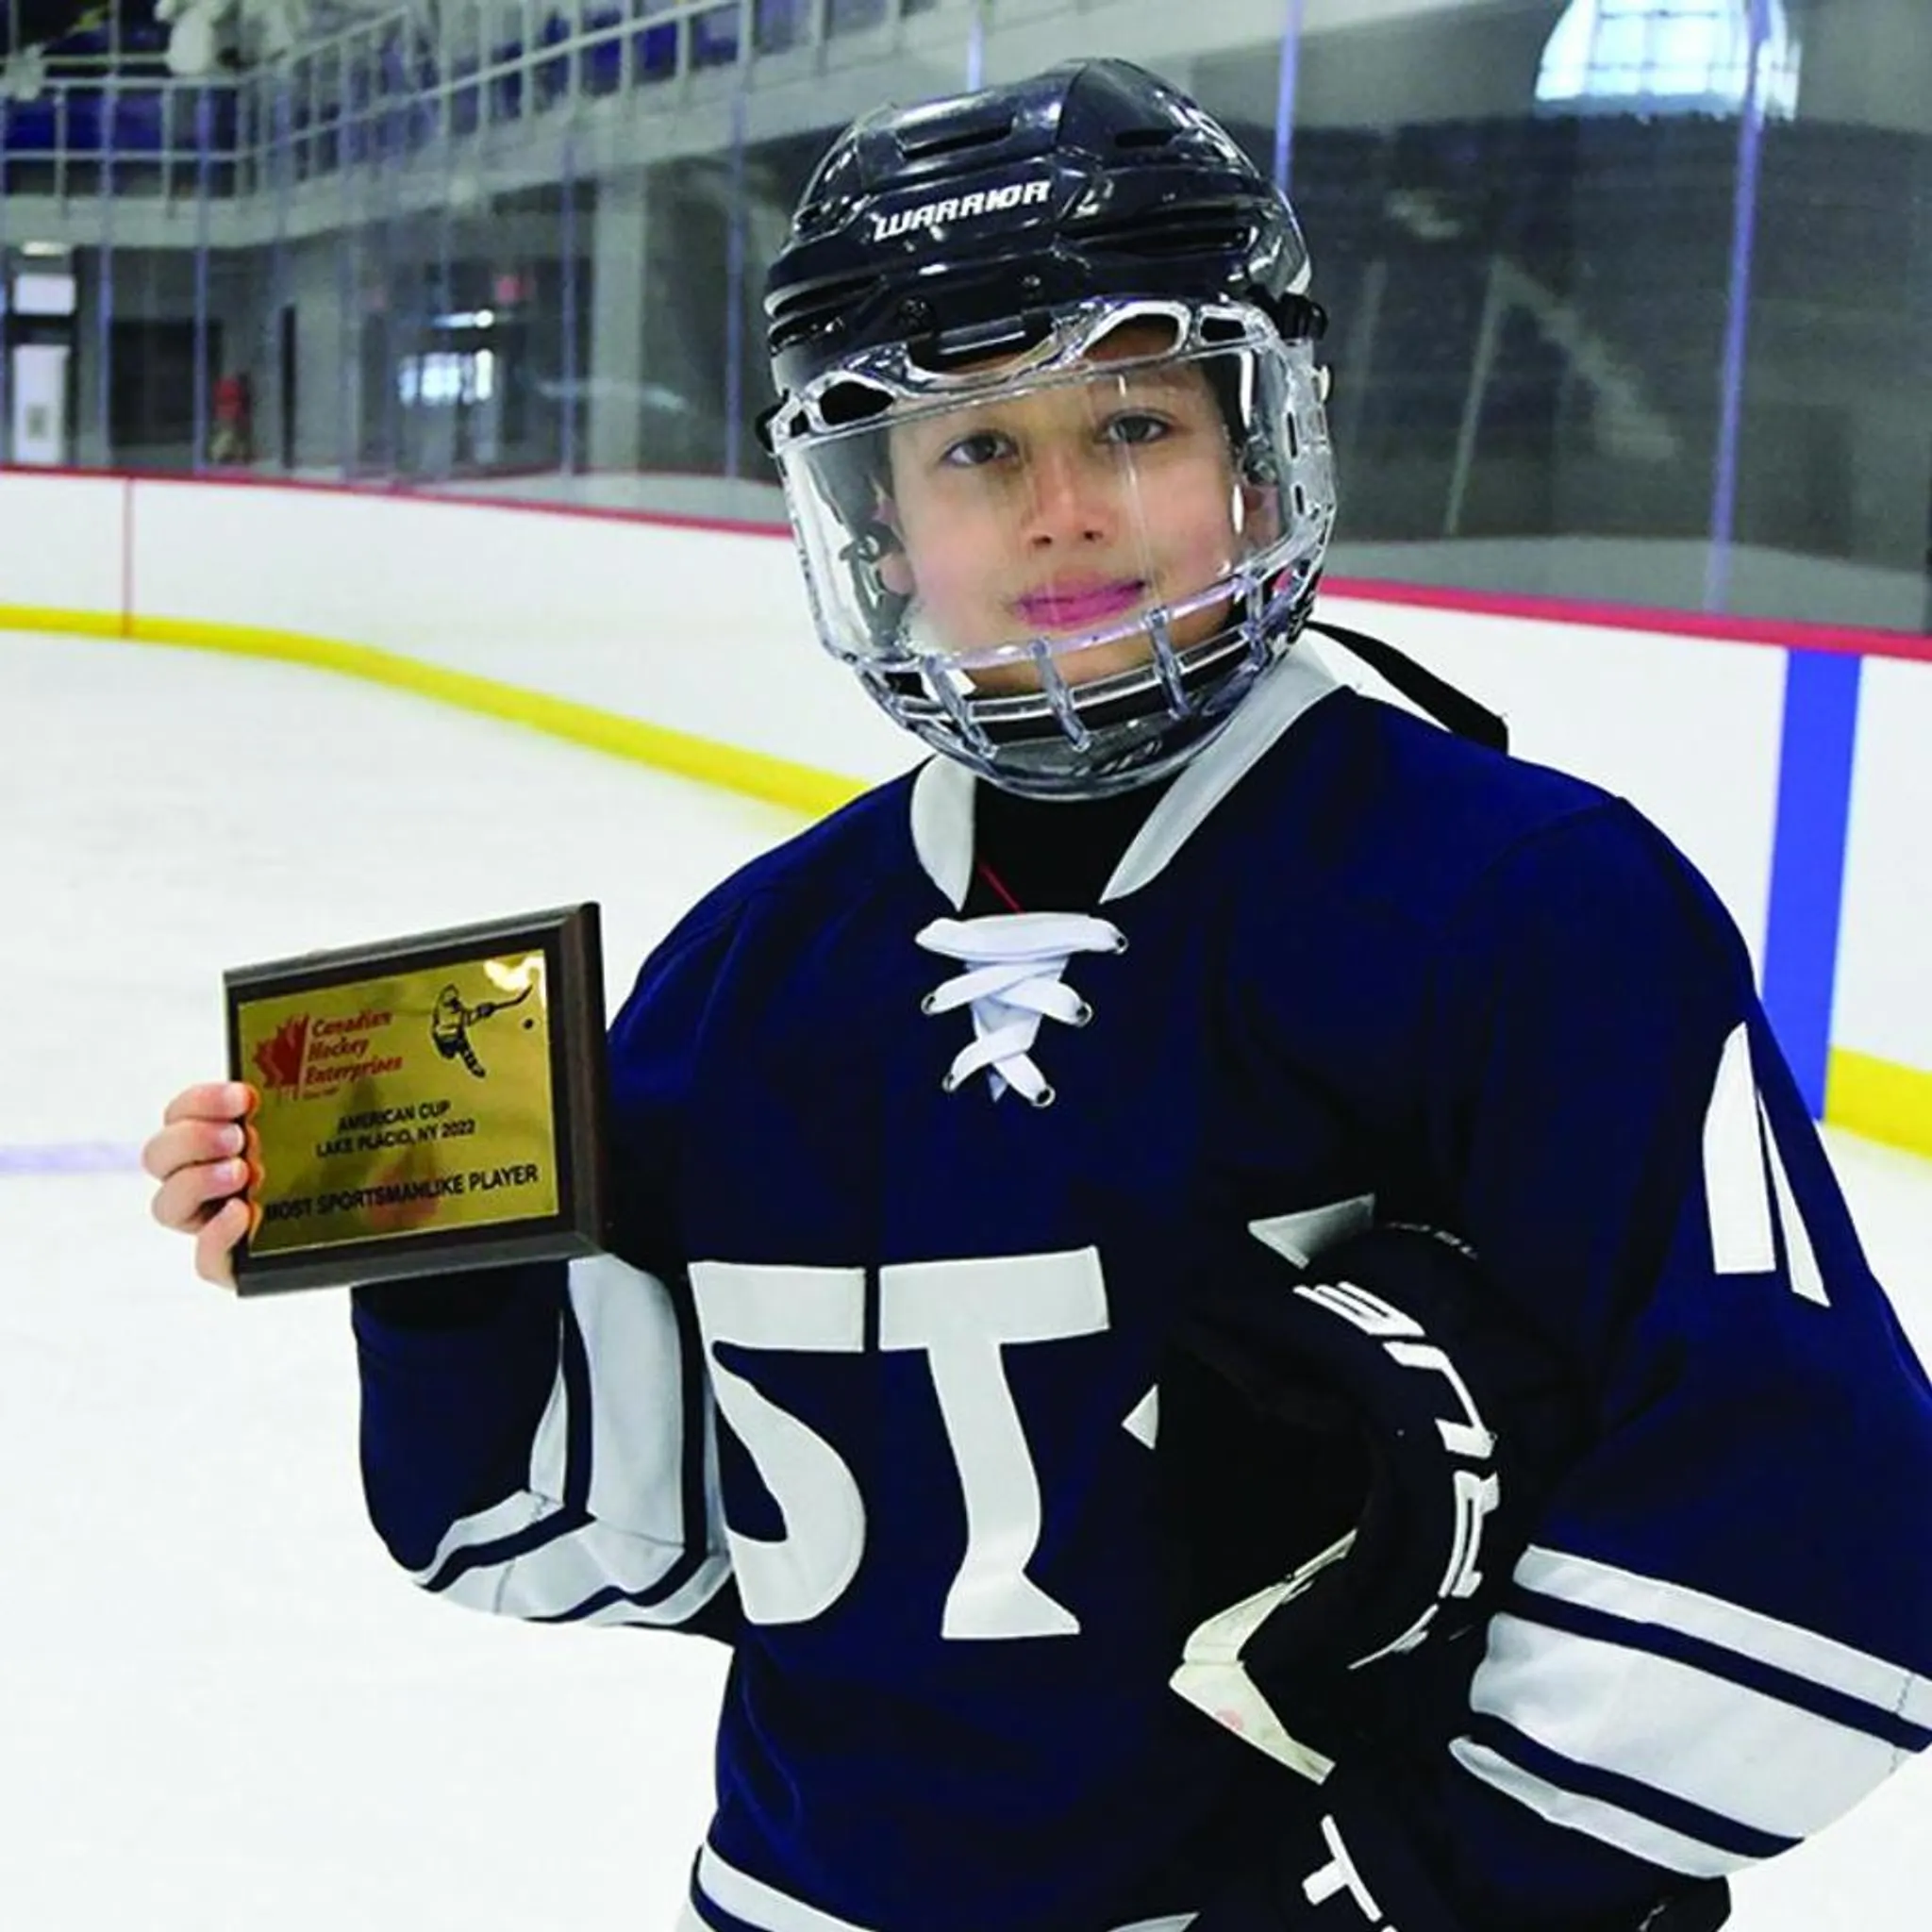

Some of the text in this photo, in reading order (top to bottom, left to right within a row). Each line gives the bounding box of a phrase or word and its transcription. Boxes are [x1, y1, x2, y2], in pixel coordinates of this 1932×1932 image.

[874, 181, 1051, 242] WARRIOR
[312, 1010, 393, 1037] Canadian
[308, 1038, 369, 1061] Hockey
[305, 1057, 403, 1086] Enterprises
[338, 1100, 451, 1133] AMERICAN CUP
[316, 1137, 353, 1158] LAKE
[418, 1124, 439, 1141] NY
[266, 1163, 538, 1221] MOST SPORTSMANLIKE PLAYER
